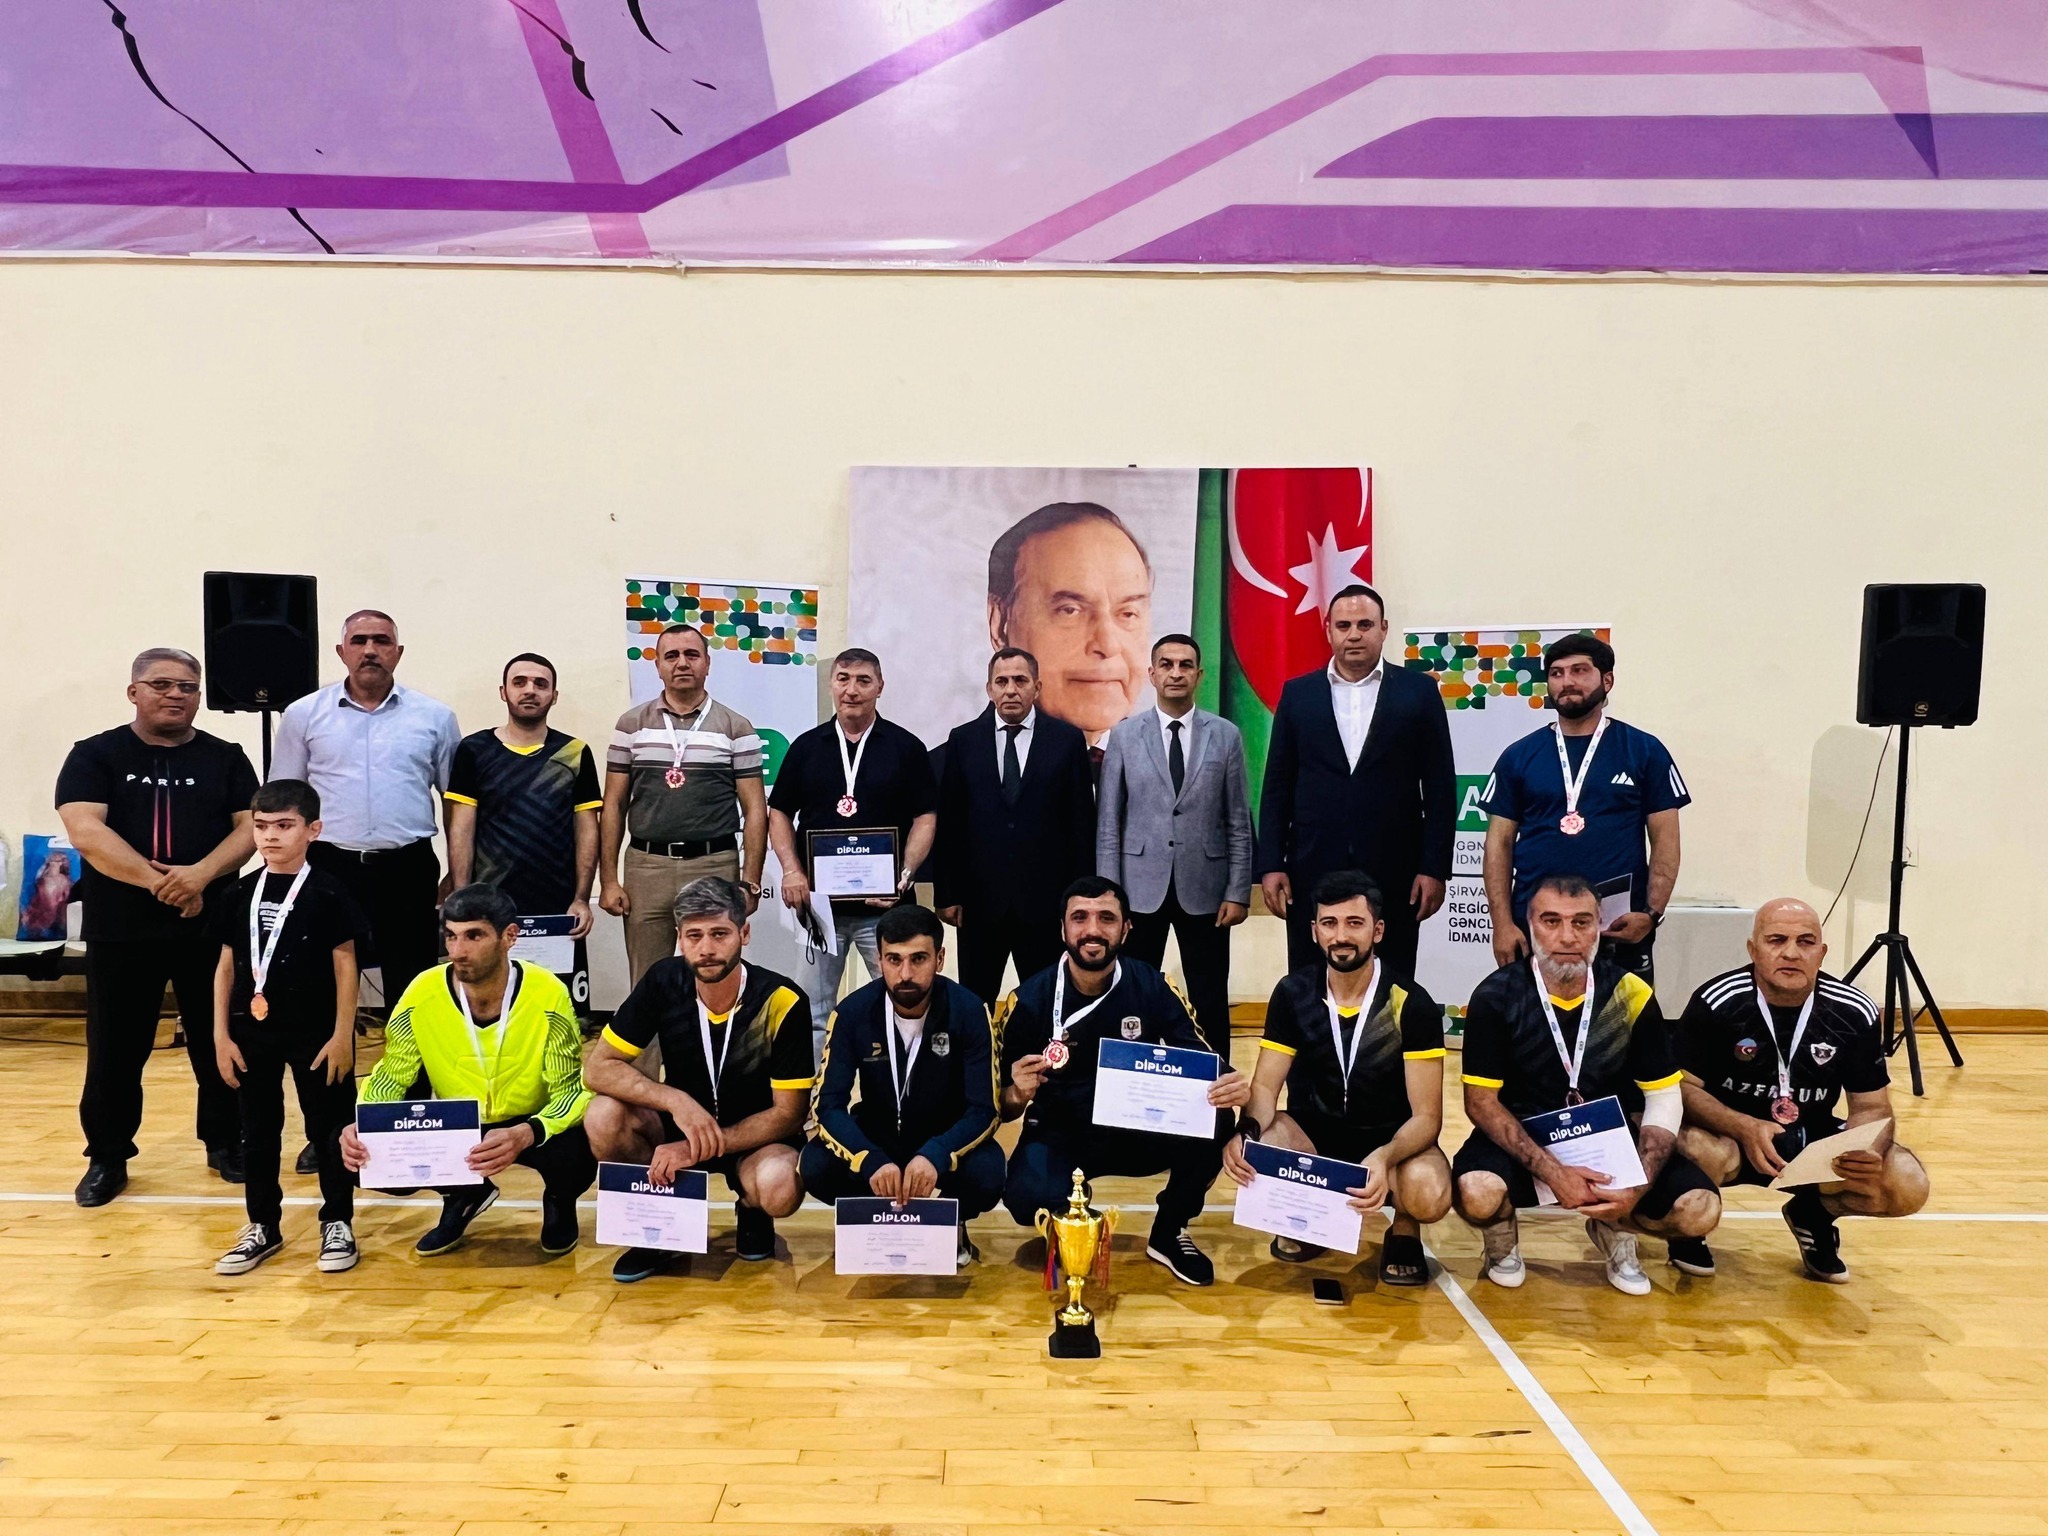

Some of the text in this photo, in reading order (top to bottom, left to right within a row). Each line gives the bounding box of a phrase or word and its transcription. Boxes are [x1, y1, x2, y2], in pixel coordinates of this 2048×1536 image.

[126, 773, 195, 787] PARIS
[836, 845, 870, 855] DİPLOM
[1449, 884, 1488, 899] ŞİRVA
[1449, 901, 1490, 914] REGİO
[1448, 917, 1494, 930] GƏNCL
[1448, 929, 1490, 943] İDMAN
[572, 970, 589, 1003] 6
[1134, 1059, 1183, 1075] DİPLOM
[1721, 1077, 1828, 1103] AZERUN
[394, 1117, 443, 1130] DİPLOM
[1549, 1122, 1592, 1142] DİPLOM
[1278, 1166, 1328, 1187] DİPLOM
[631, 1180, 675, 1195] DİPLOM
[872, 1212, 921, 1223] DİPLOM
